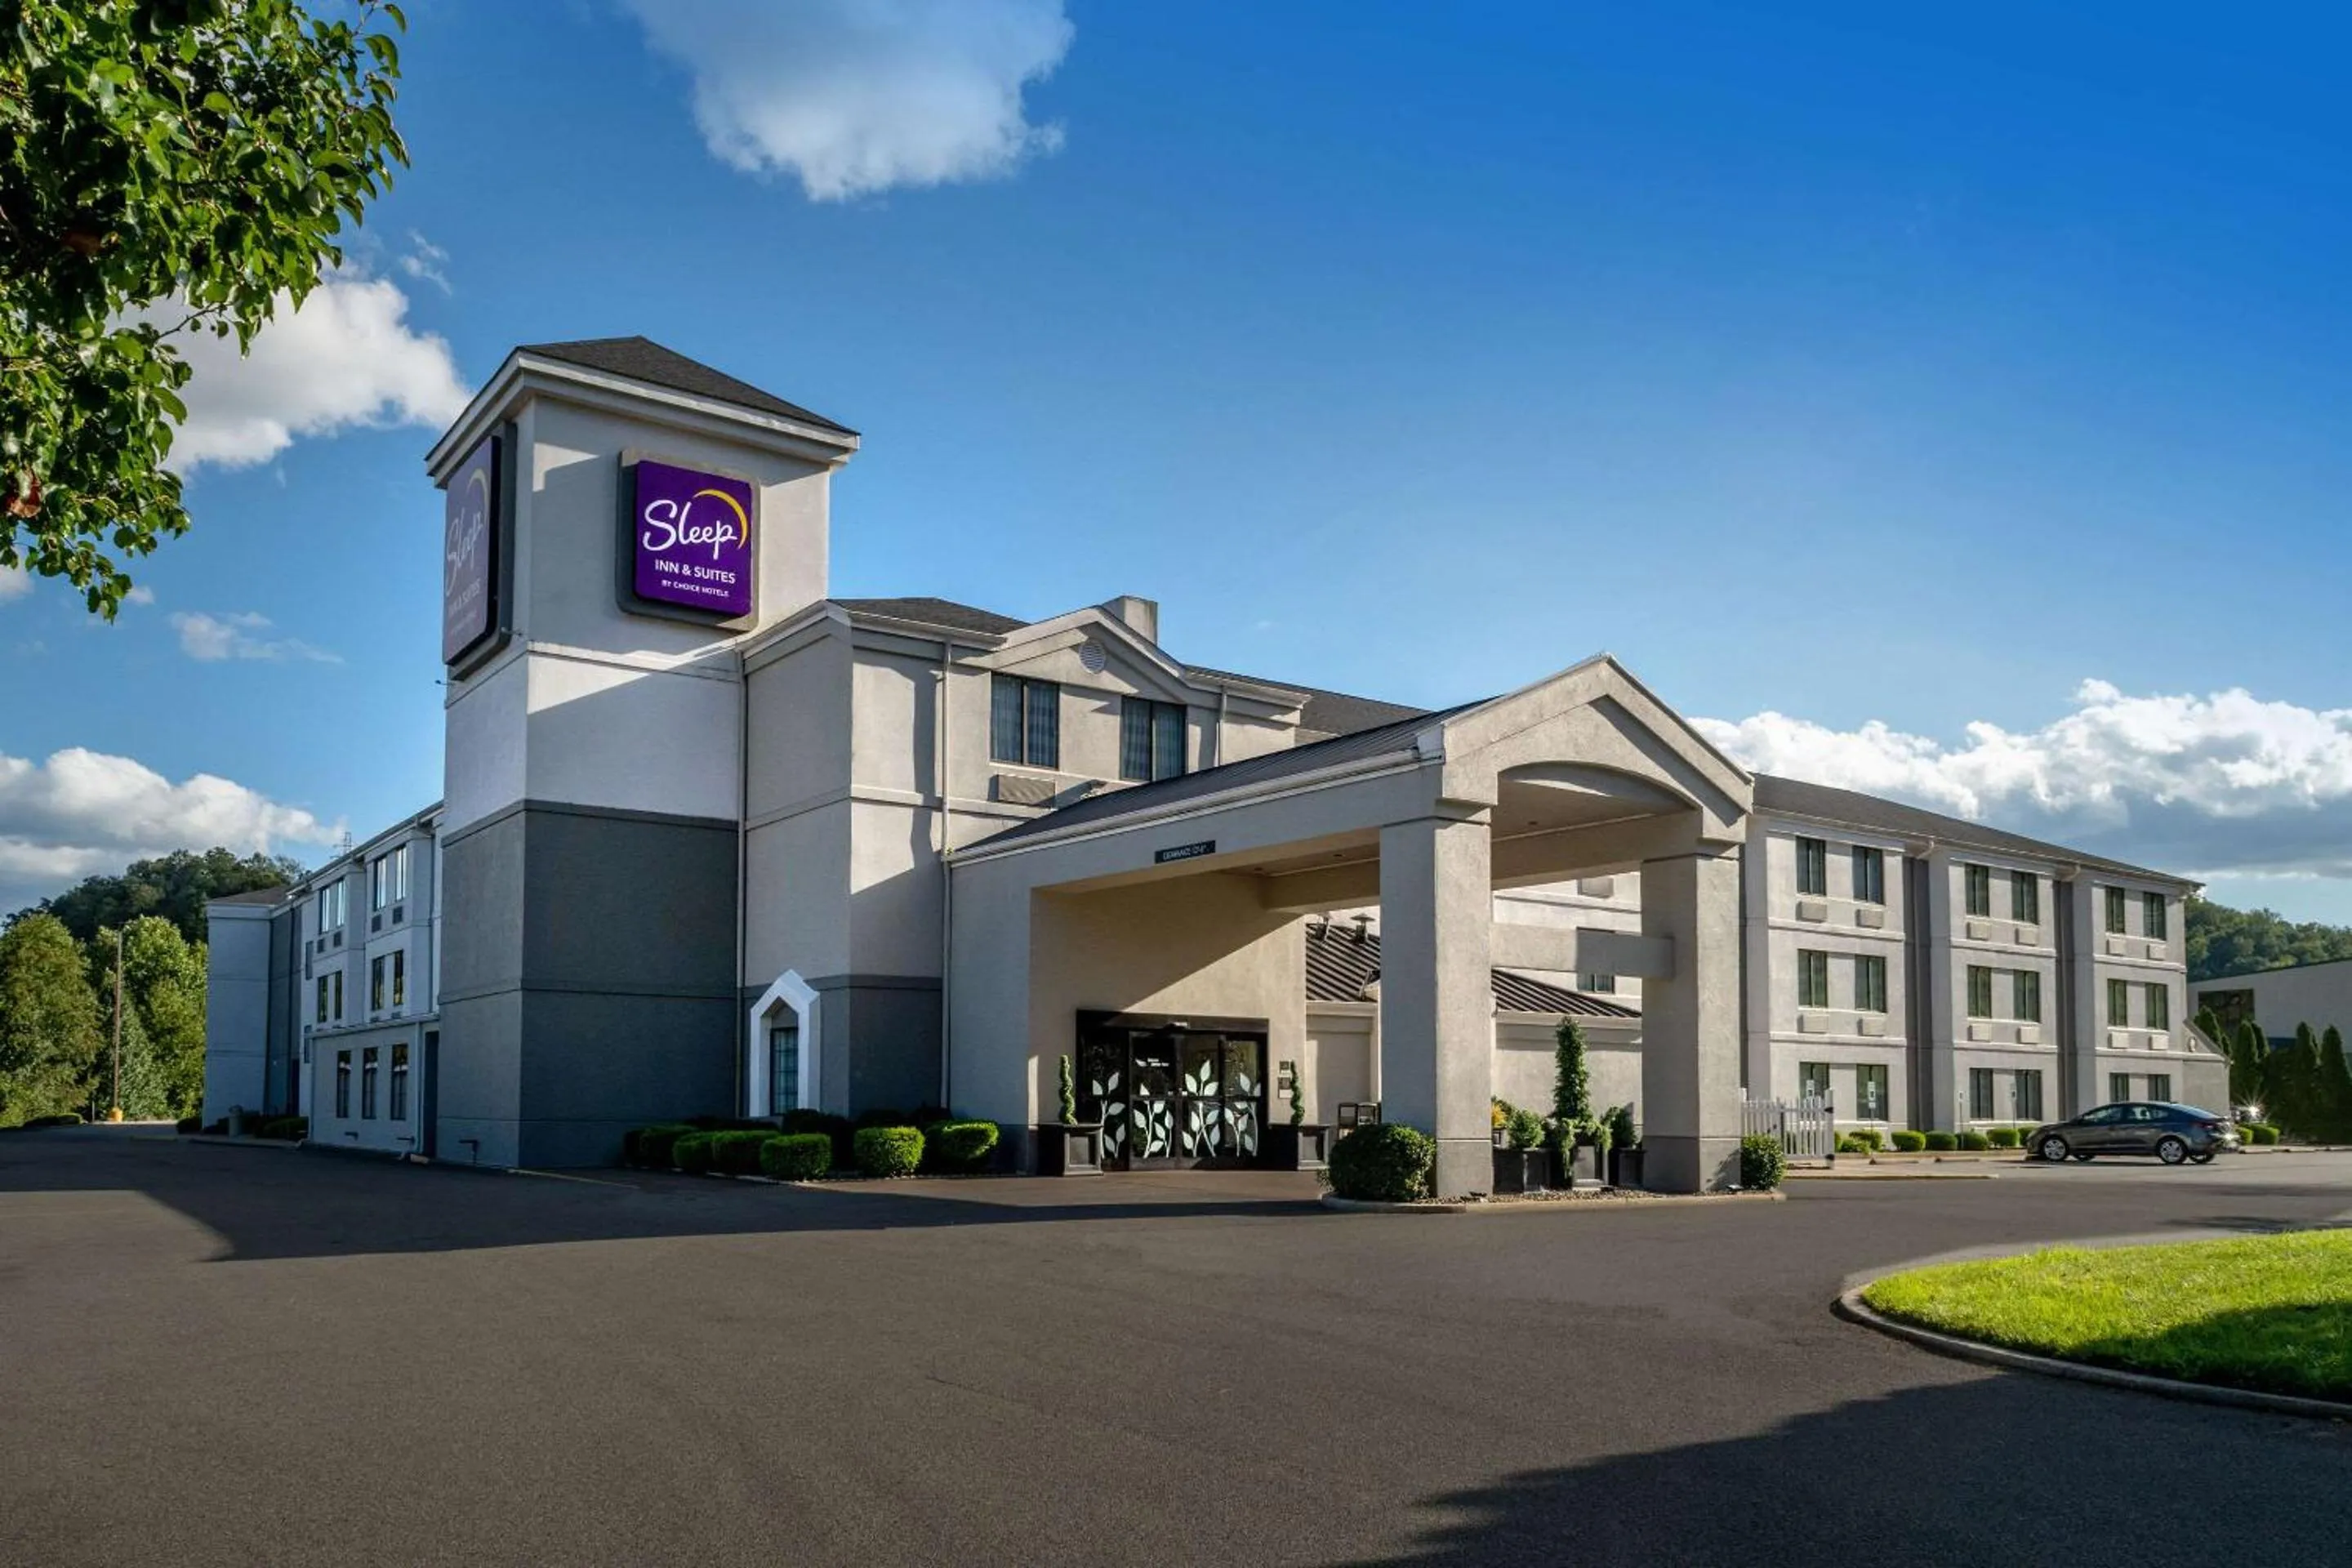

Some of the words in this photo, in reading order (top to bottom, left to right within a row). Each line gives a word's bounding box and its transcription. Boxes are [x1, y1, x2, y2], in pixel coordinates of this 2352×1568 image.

[642, 499, 737, 560] Sleep
[655, 559, 679, 574] INN
[682, 564, 692, 576] &
[694, 566, 736, 584] SUITES
[673, 581, 700, 594] CHOICE
[702, 586, 729, 598] HOTELS
